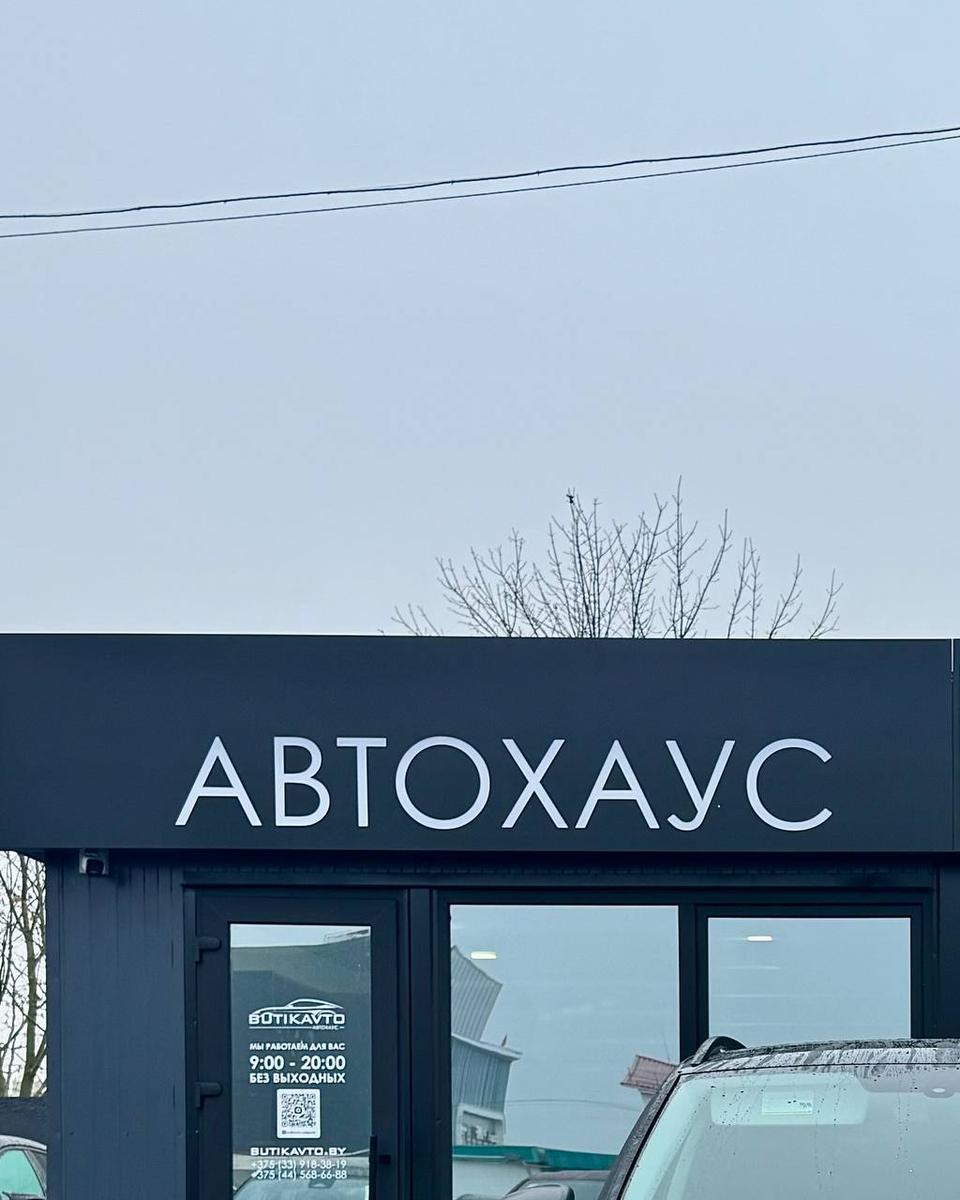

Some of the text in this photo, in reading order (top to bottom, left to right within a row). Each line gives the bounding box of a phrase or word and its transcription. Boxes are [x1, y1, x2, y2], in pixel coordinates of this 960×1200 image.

[174, 735, 834, 832] АВТОХАУС
[248, 1013, 346, 1025] BUTIKAVTO
[249, 1043, 264, 1051] МЫ
[309, 1043, 327, 1051] ДЛЯ
[328, 1043, 346, 1051] ВАС
[249, 1055, 284, 1070] 9:00
[301, 1055, 346, 1070] 20:00
[249, 1072, 346, 1085] БЕЗ ВЫХОДНЫХ
[250, 1147, 347, 1156] BUTIKAVTO.BY
[251, 1159, 276, 1169] +375
[278, 1159, 297, 1170] (33)
[278, 1170, 297, 1181] (44)
[299, 1170, 348, 1180] 568-66-88
